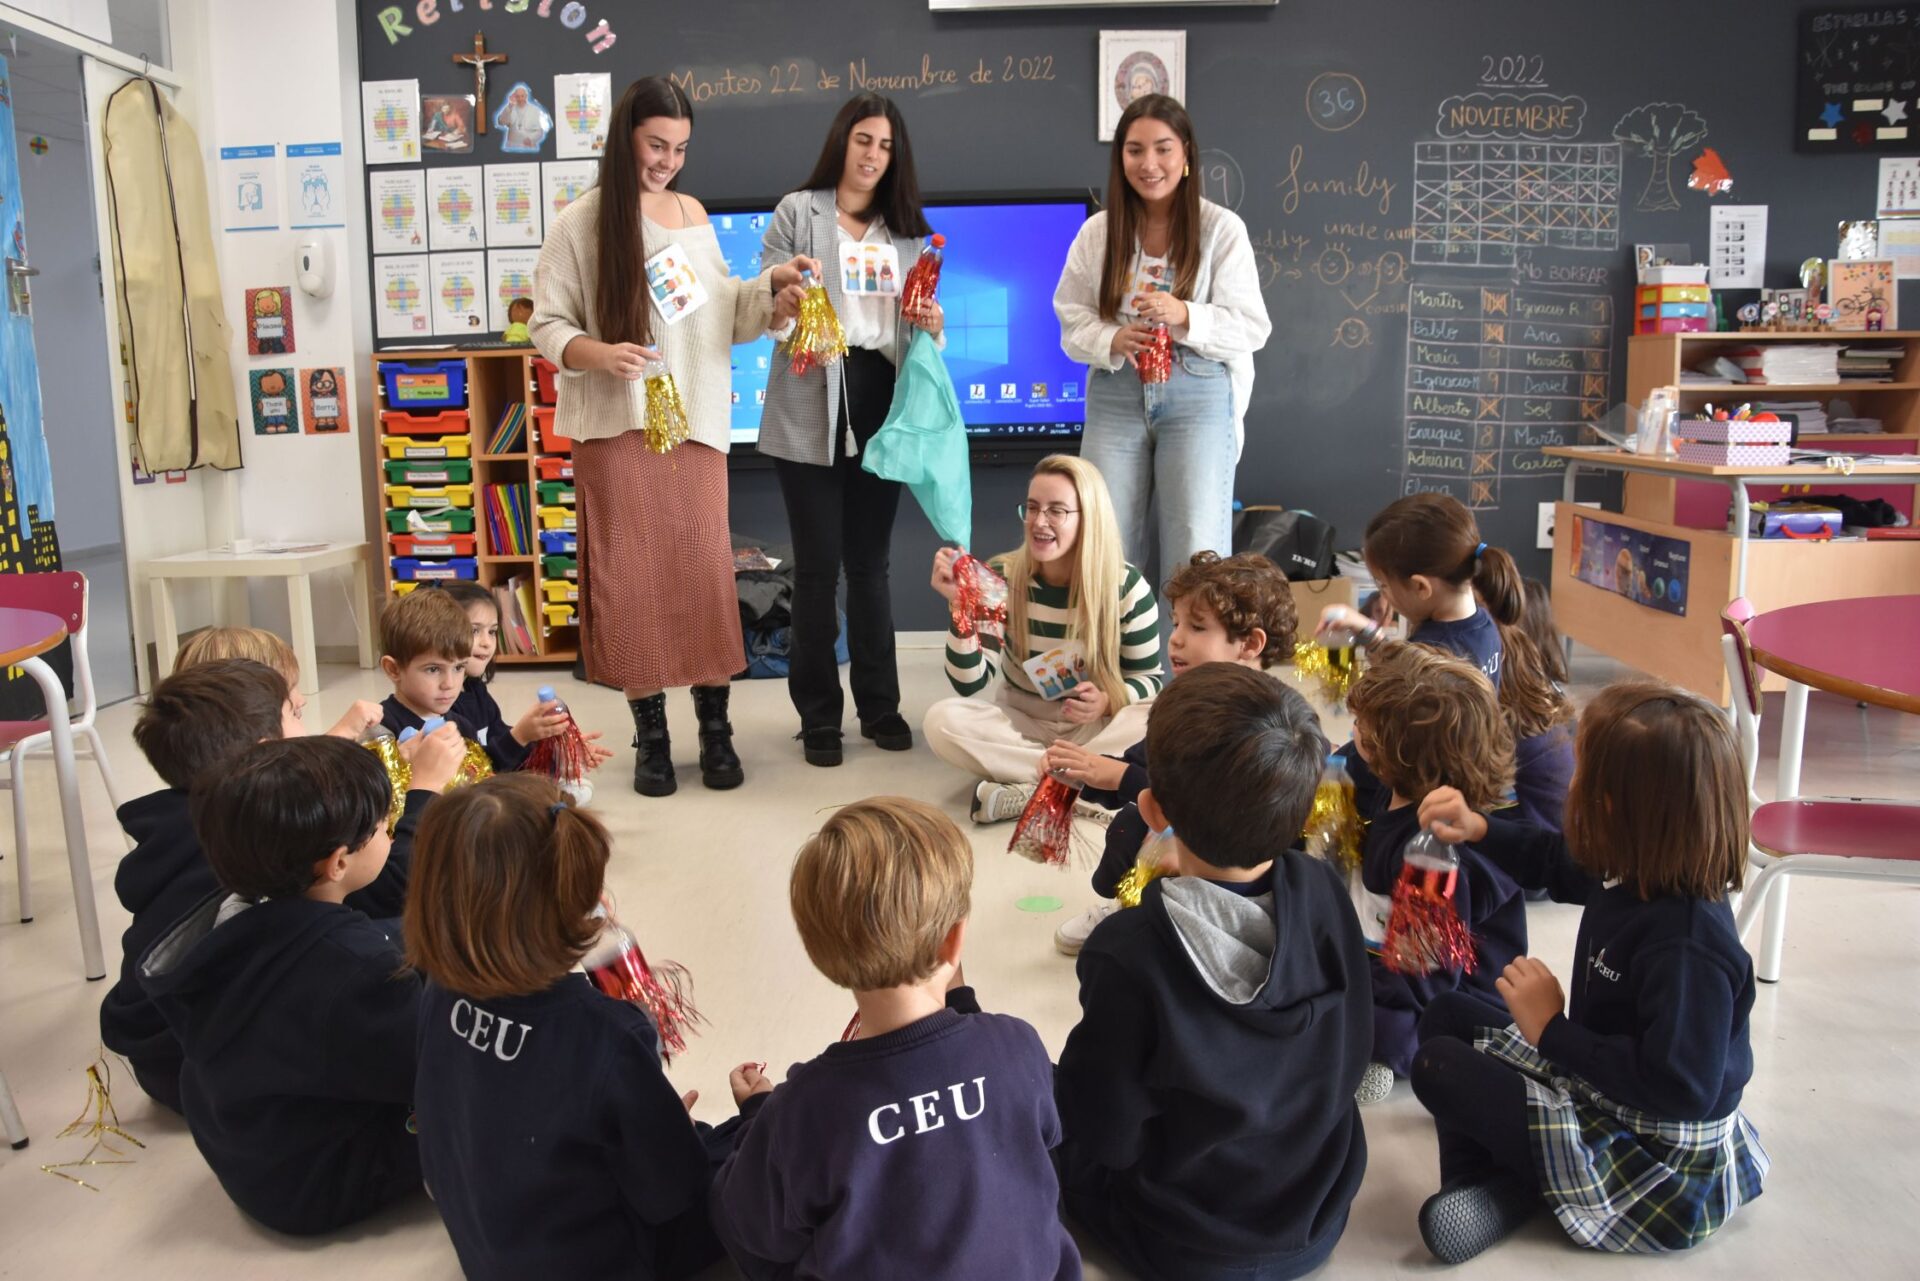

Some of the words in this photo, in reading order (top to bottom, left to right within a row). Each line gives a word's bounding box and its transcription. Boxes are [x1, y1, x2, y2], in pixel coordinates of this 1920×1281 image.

[670, 68, 761, 102] Martes
[770, 63, 803, 93] 22
[817, 68, 840, 90] de
[970, 58, 993, 84] de
[1319, 87, 1355, 118] 36
[1451, 105, 1575, 132] NOVIEMBRE
[1276, 144, 1396, 216] family
[1323, 221, 1380, 241] uncle
[1251, 229, 1311, 262] addy
[1523, 325, 1562, 344] Ana
[1524, 375, 1568, 394] Daniel
[1413, 395, 1472, 417] Alberto
[1523, 400, 1552, 421] Sol
[1407, 421, 1464, 448] Enrique
[1514, 425, 1564, 446] Marta
[1407, 450, 1466, 471] Adriana
[1512, 453, 1567, 471] Carlos
[450, 998, 532, 1062] CEU
[867, 1076, 988, 1145] CEU
